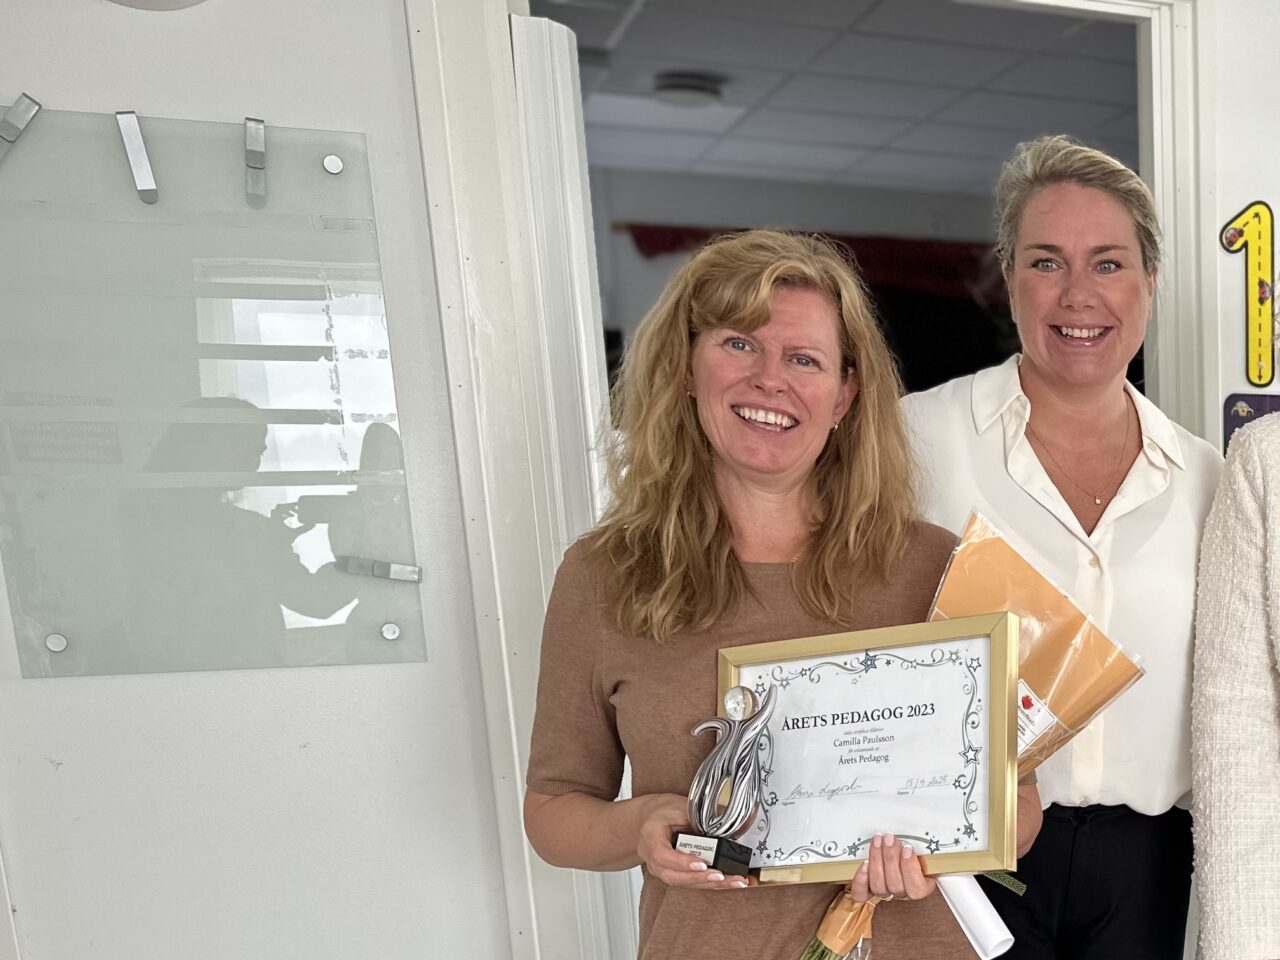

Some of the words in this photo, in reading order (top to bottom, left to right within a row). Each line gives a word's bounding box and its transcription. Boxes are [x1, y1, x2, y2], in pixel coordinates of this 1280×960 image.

[781, 715, 828, 731] ÅRETS
[831, 706, 903, 726] PEDAGOG
[906, 702, 935, 718] 2023
[833, 737, 861, 748] Camilla
[862, 734, 895, 745] Paulsson
[838, 754, 858, 765] Årets
[859, 753, 890, 764] Pedagog
